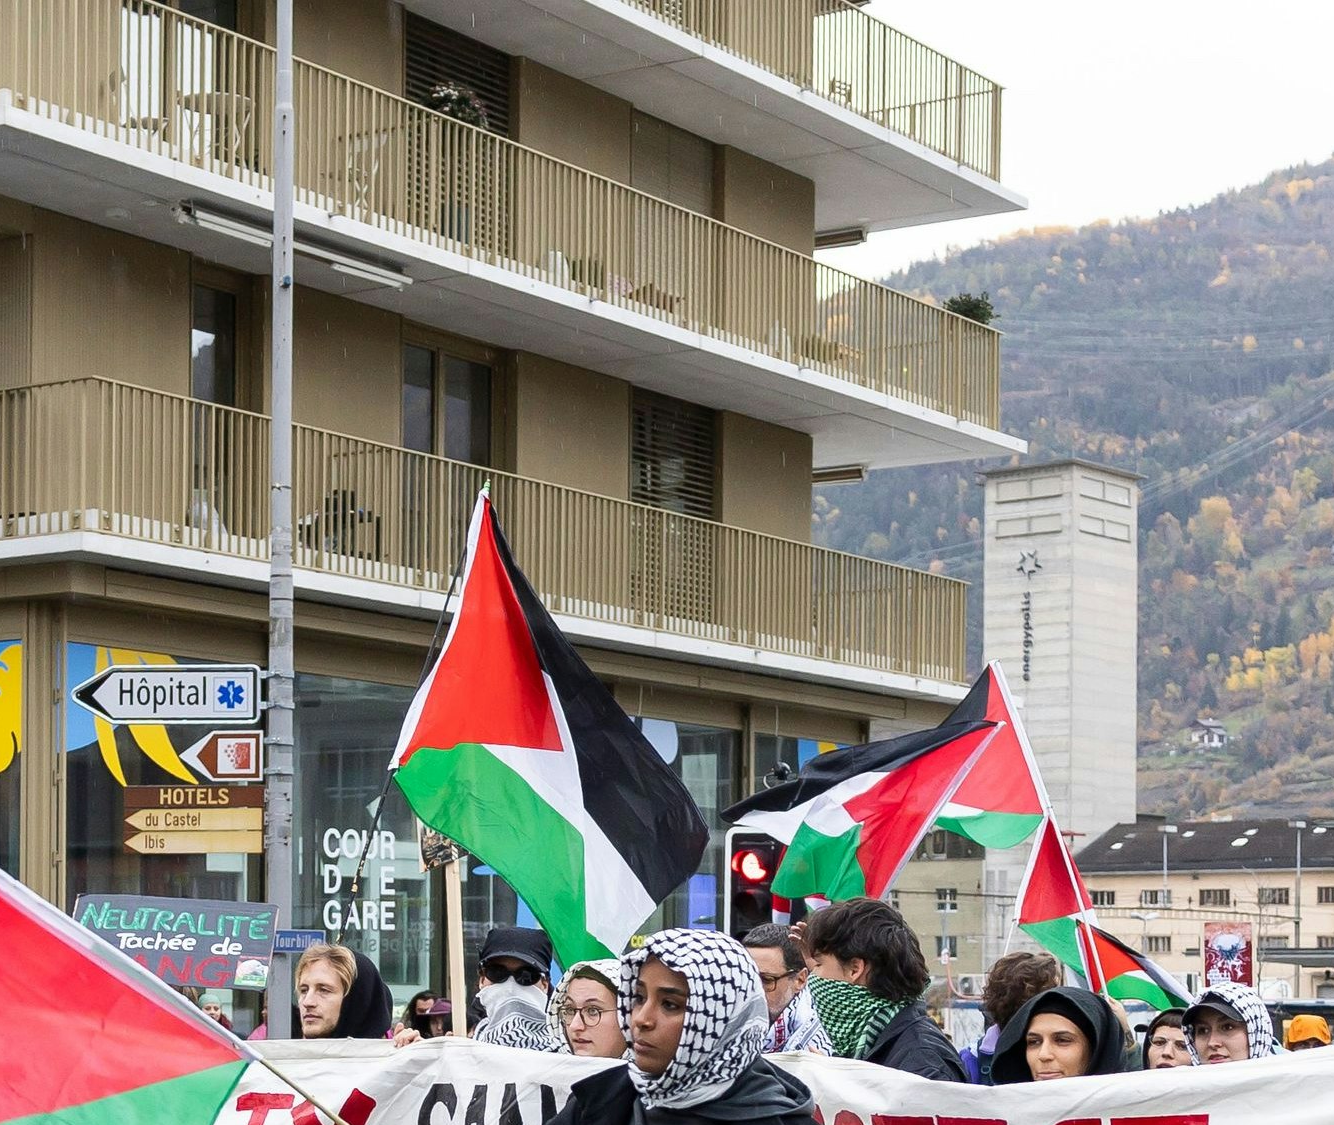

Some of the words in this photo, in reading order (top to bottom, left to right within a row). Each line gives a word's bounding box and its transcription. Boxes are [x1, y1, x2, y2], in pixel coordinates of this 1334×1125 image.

[1022, 591, 1033, 681] energypolis
[119, 676, 206, 713] Hôpital
[159, 788, 229, 805] HOTELS
[145, 812, 159, 826] du
[164, 812, 201, 826] Castel
[144, 834, 165, 848] Ibis
[323, 828, 396, 859] COUR
[80, 901, 272, 940] NEUTRALITÉ
[323, 900, 396, 931] GARE
[116, 932, 197, 951] Tachée
[210, 936, 243, 956] de
[133, 952, 233, 988] NG
